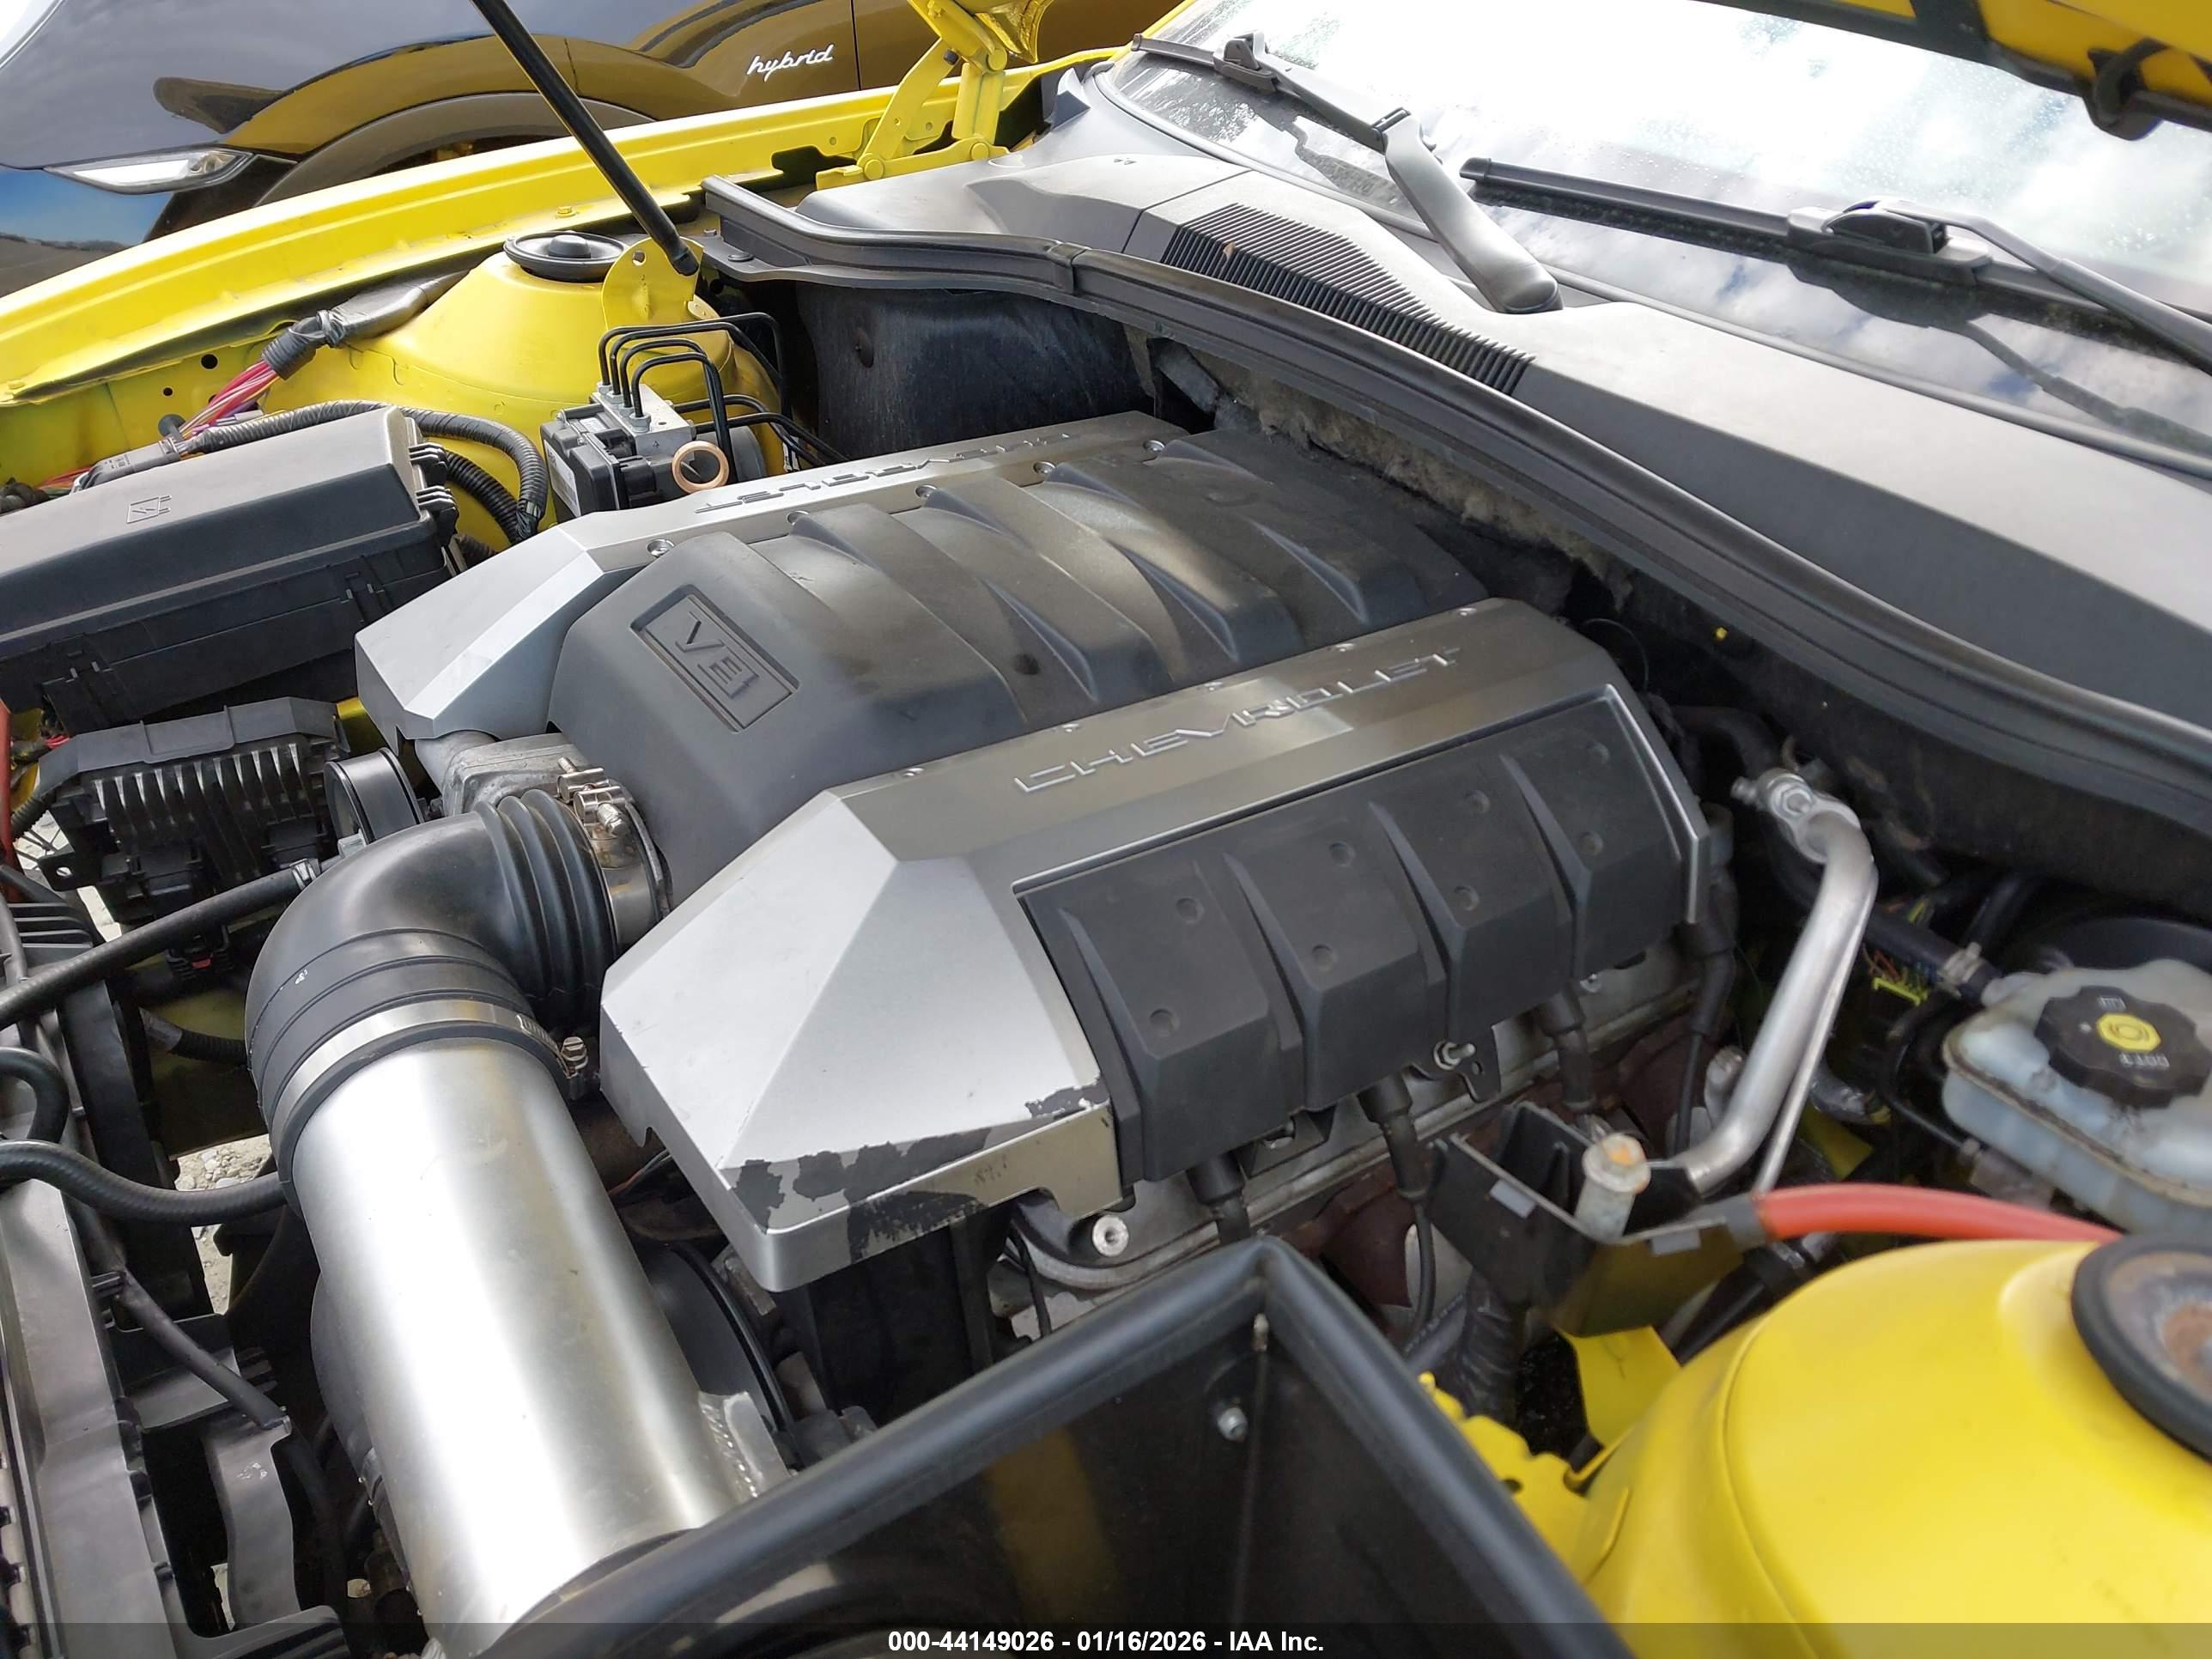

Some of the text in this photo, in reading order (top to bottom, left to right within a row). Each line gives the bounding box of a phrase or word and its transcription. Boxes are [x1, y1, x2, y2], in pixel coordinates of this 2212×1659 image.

[746, 44, 834, 82] hybrid
[674, 611, 760, 700] V8
[1014, 647, 1462, 792] CHEVROLET
